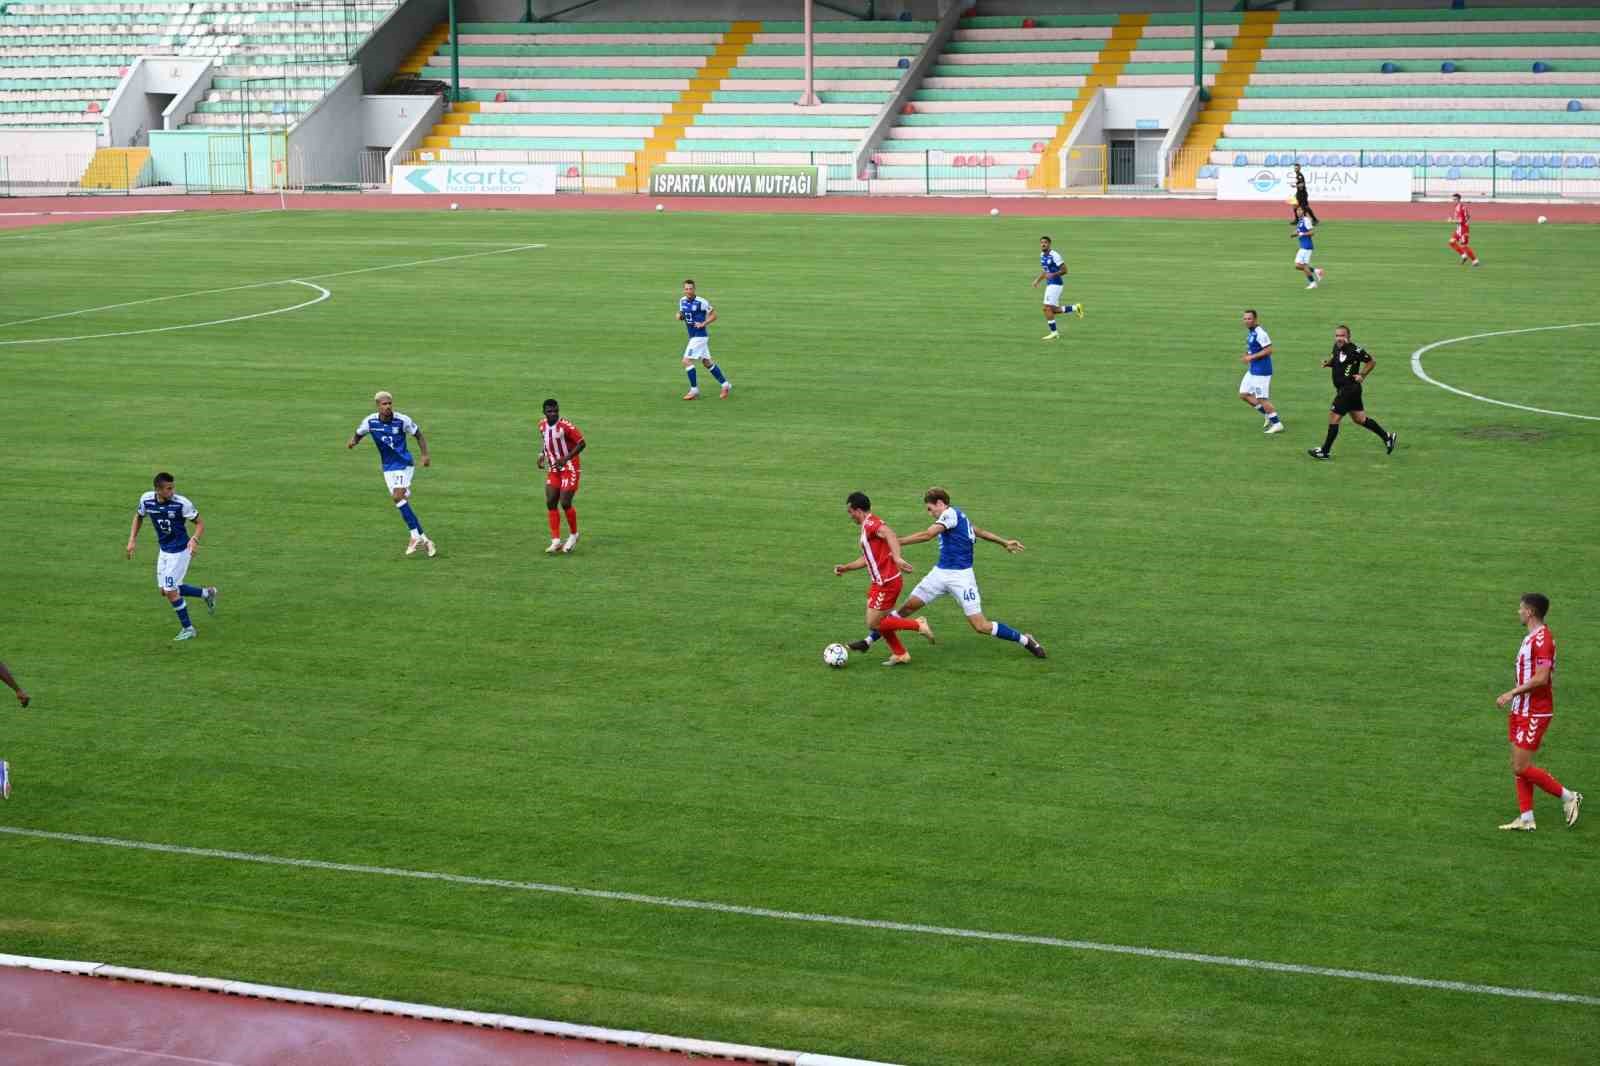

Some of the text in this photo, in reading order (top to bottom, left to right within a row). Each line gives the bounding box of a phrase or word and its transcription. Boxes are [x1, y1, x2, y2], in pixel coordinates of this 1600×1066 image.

[654, 172, 811, 194] ISPARTA KONYA MUTFAĞI
[165, 575, 174, 588] 19
[963, 587, 976, 601] 46
